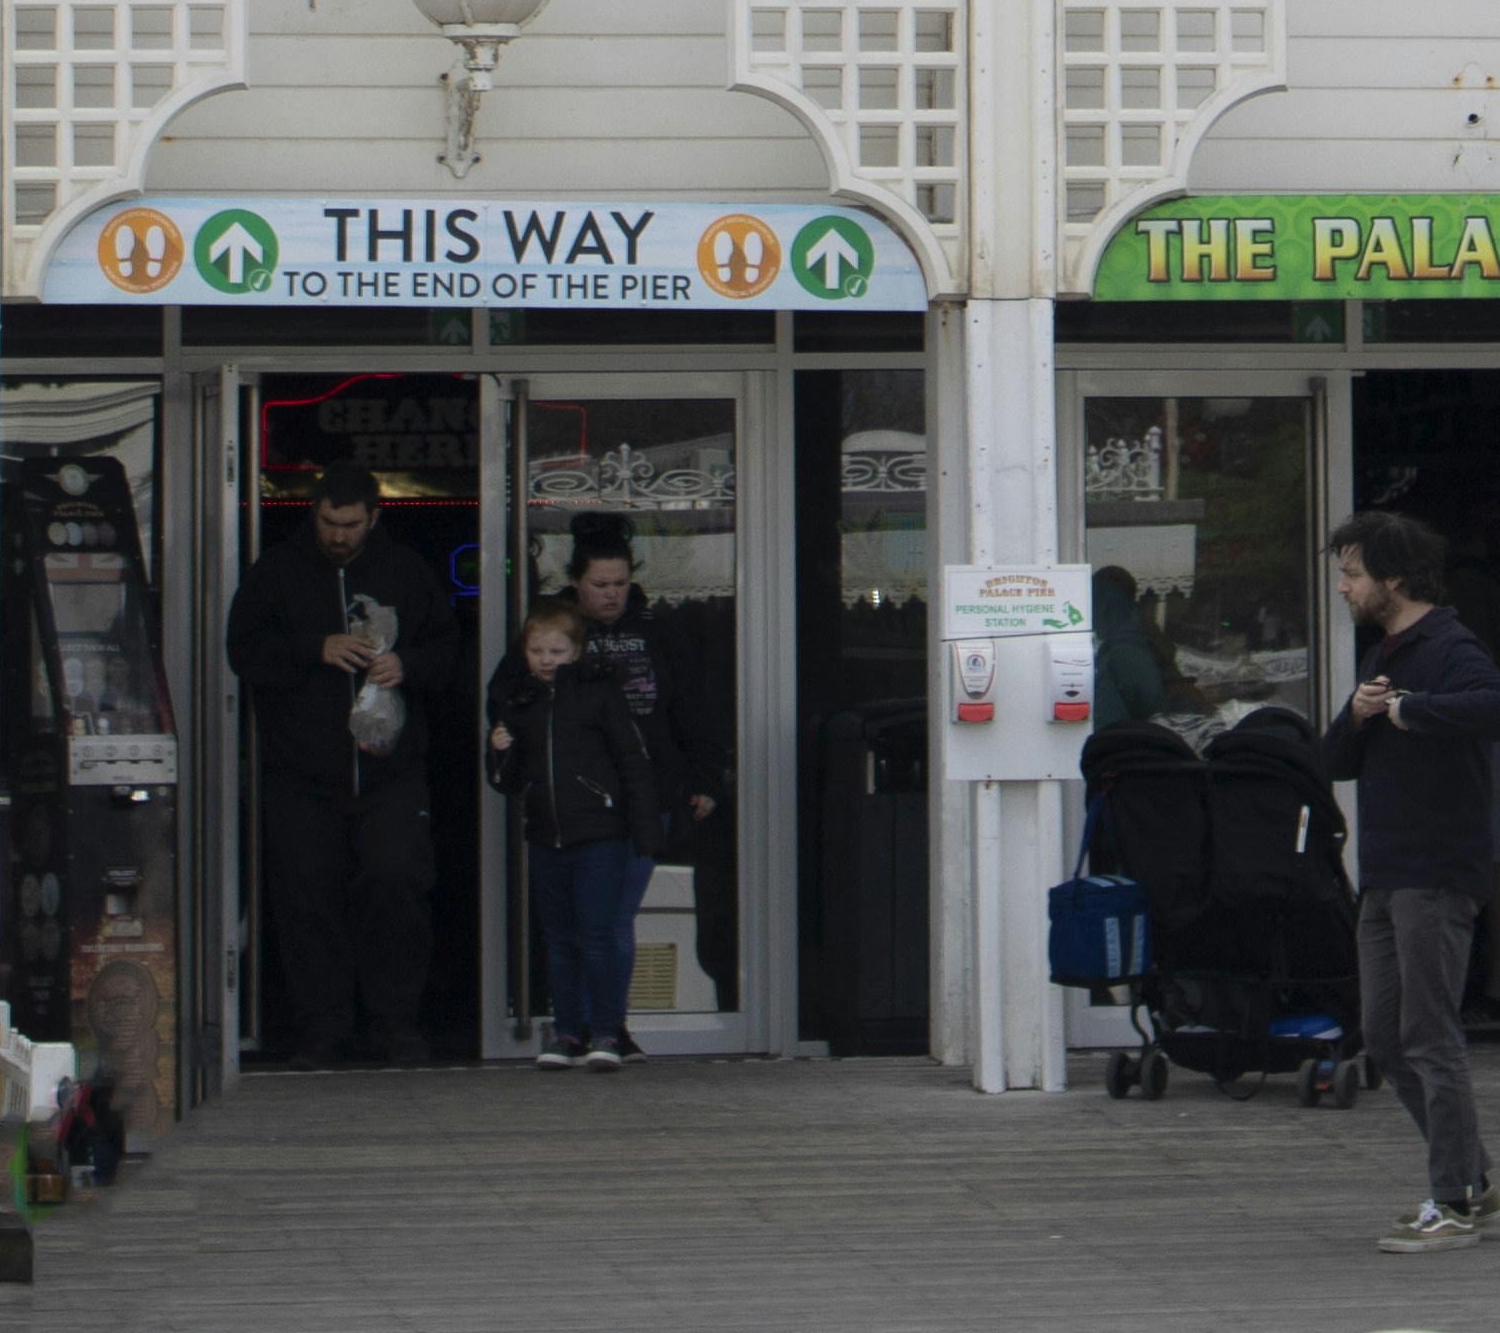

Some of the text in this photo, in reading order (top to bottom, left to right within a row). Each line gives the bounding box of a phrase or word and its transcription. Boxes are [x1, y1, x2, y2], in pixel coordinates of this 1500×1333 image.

[324, 208, 480, 264] THIS
[503, 211, 655, 265] WAY
[1136, 217, 1276, 282] THE
[283, 271, 327, 297] TO
[336, 272, 402, 298] THE
[411, 272, 482, 298] END
[492, 273, 537, 299] OF
[546, 274, 610, 300] THE
[622, 274, 691, 301] PIER
[318, 398, 479, 433] CHAN
[985, 574, 1049, 588] BRIGHTON
[979, 588, 1056, 598] PALACE PIER
[955, 603, 1055, 614] PERSONAL HYGIENE
[984, 618, 1027, 628] STATION
